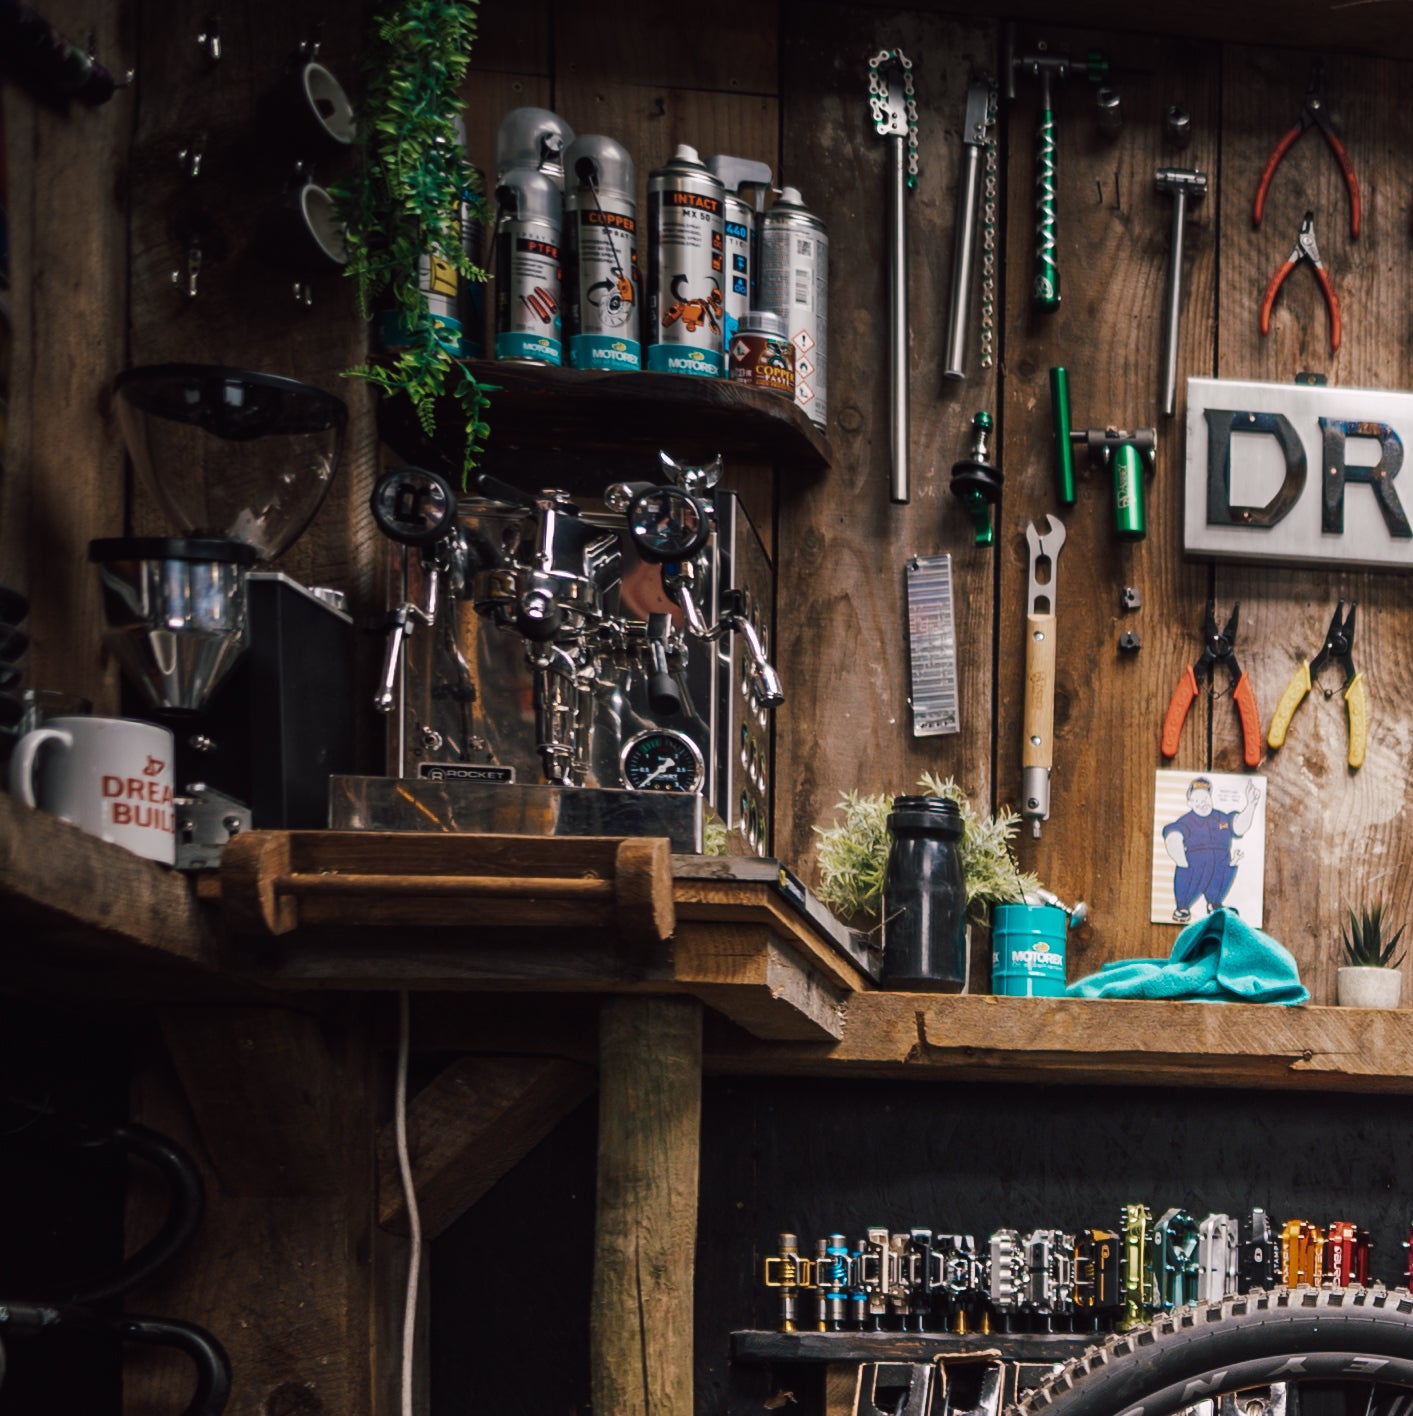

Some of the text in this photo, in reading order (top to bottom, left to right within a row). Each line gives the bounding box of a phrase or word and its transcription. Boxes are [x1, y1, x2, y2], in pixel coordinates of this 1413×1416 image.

[673, 192, 717, 212] INTACT
[588, 211, 635, 230] COPPER
[681, 208, 711, 223] MX 50
[726, 223, 747, 238] 440
[522, 341, 560, 357] MOTOREX
[592, 349, 639, 364] MOTOREX
[668, 358, 719, 377] MOTOREX
[446, 769, 505, 780] ROCKET
[102, 776, 174, 807] DREA
[1012, 951, 1063, 966] MOTOREX
